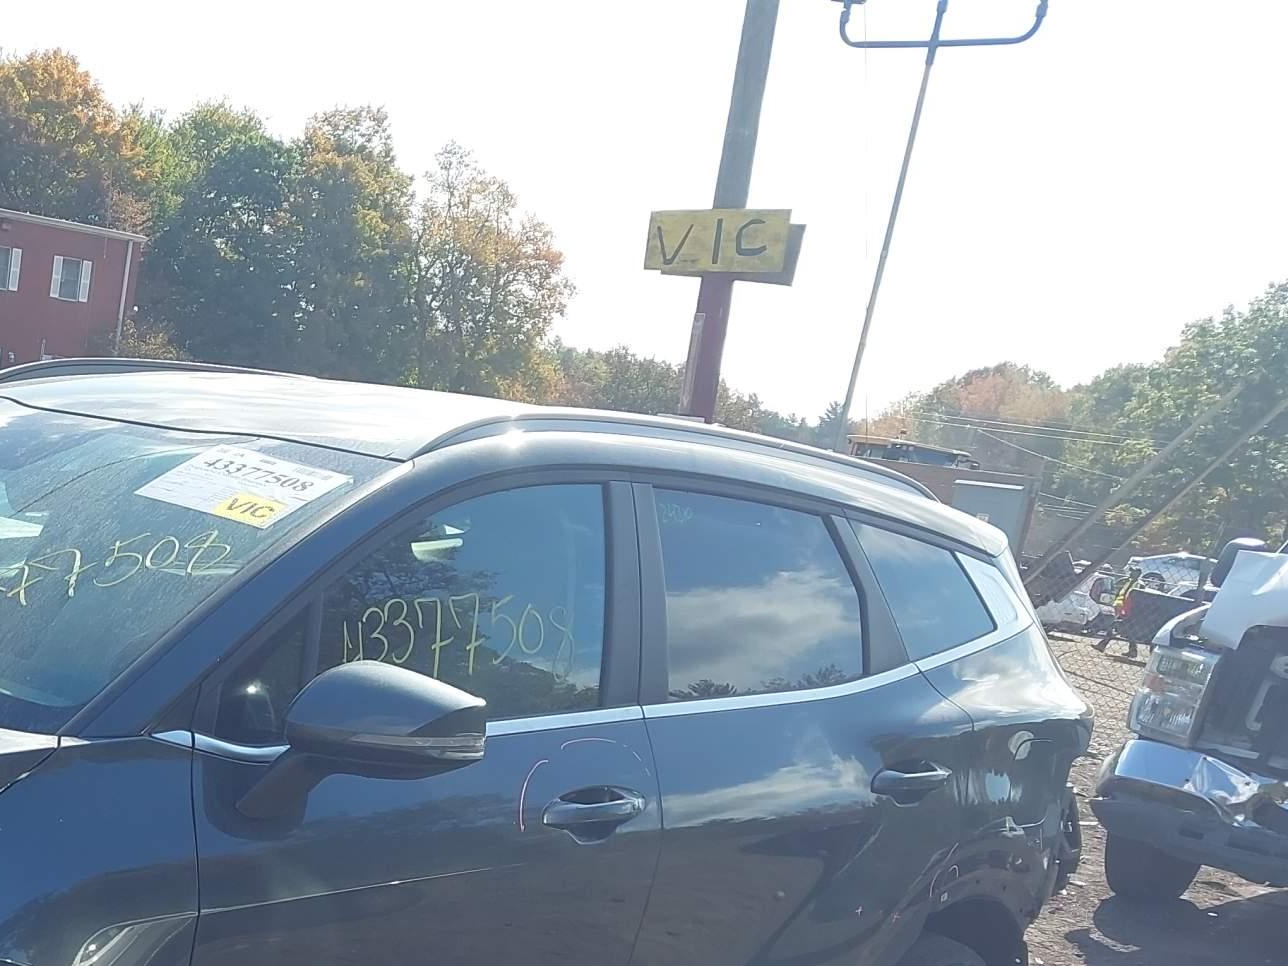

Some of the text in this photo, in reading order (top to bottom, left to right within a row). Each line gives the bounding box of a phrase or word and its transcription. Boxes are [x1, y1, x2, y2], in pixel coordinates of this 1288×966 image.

[657, 218, 767, 266] VIC
[204, 458, 314, 492] 43377508
[226, 497, 275, 518] VIC
[342, 593, 574, 683] 43377508
